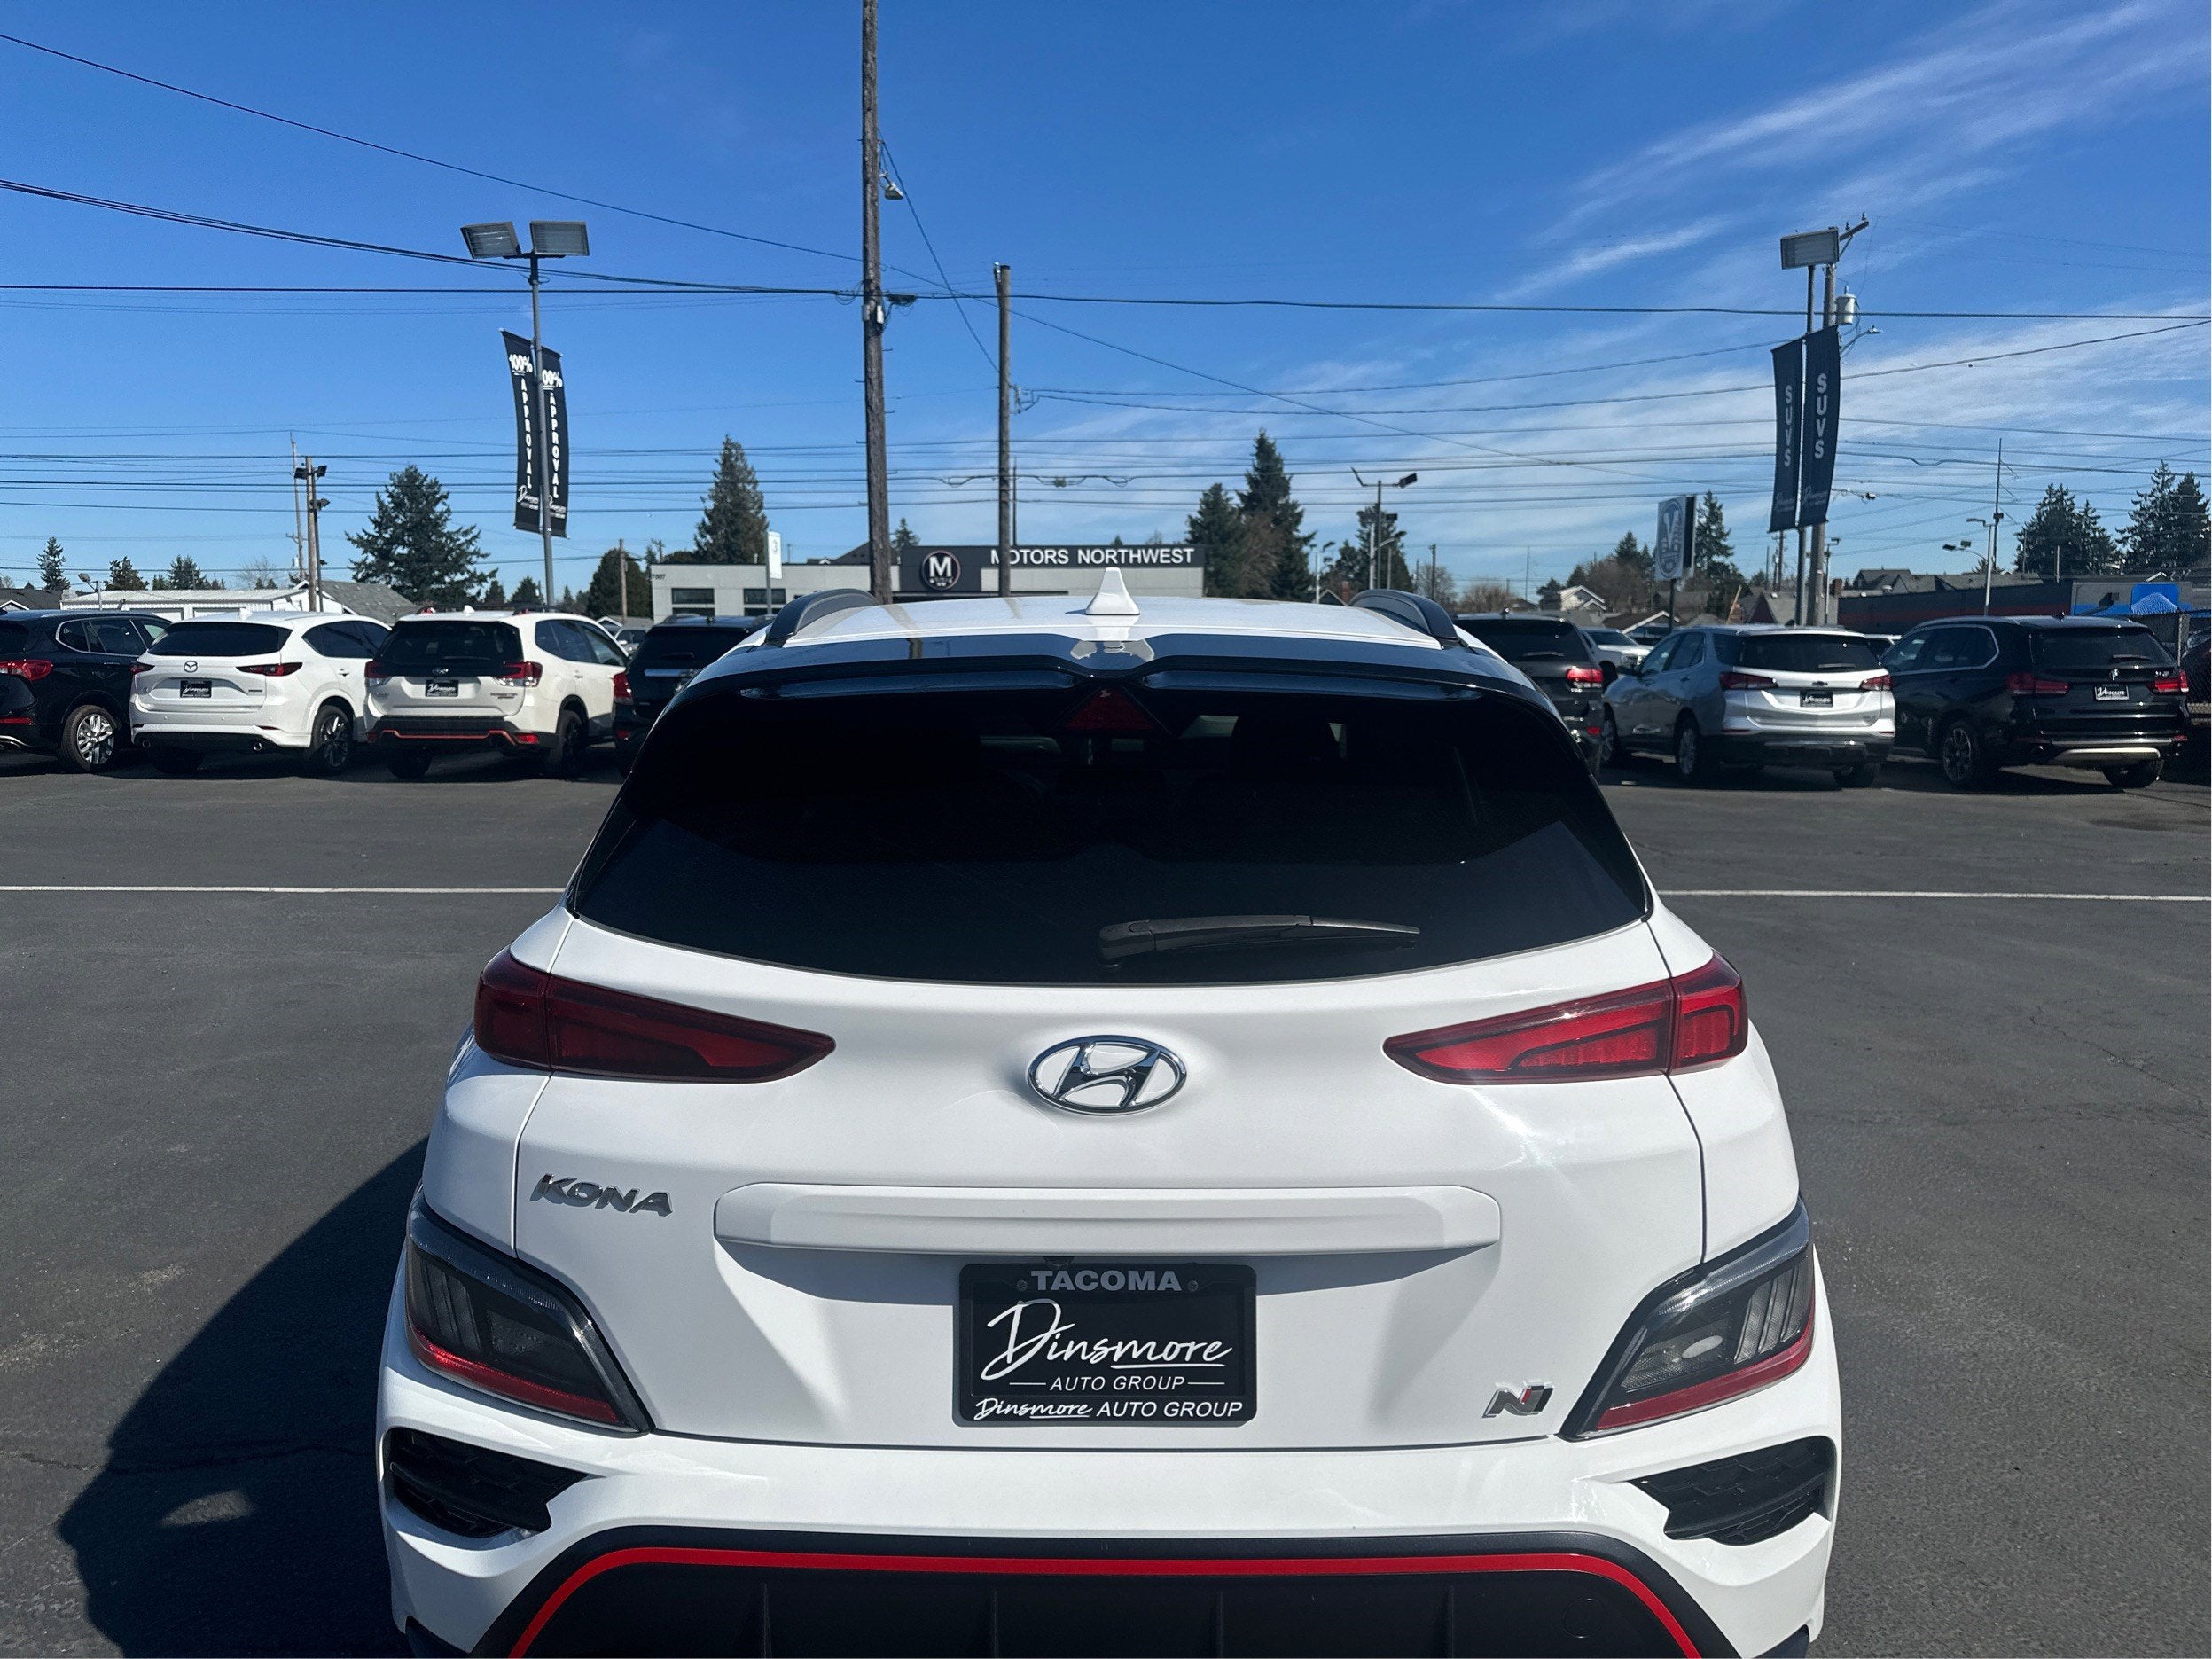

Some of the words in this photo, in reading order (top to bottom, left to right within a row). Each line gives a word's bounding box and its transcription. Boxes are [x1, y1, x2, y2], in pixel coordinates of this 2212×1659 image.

[509, 354, 533, 372] 100%
[542, 369, 563, 387] 00%
[1815, 373, 1827, 459] SUVS
[521, 378, 532, 489] APPROVAL
[550, 392, 559, 498] APPROVAL
[929, 555, 952, 577] M
[1078, 547, 1194, 564] NORTHWEST
[529, 1173, 673, 1217] KONA
[1031, 1270, 1182, 1291] TACOMA
[981, 1298, 1232, 1381] Dinsmore
[1050, 1376, 1106, 1391] AUTO
[1113, 1375, 1184, 1390] GROUP
[973, 1397, 1092, 1420] Dinsmore
[1096, 1401, 1157, 1418] AUTO
[1163, 1401, 1243, 1418] GROUP
